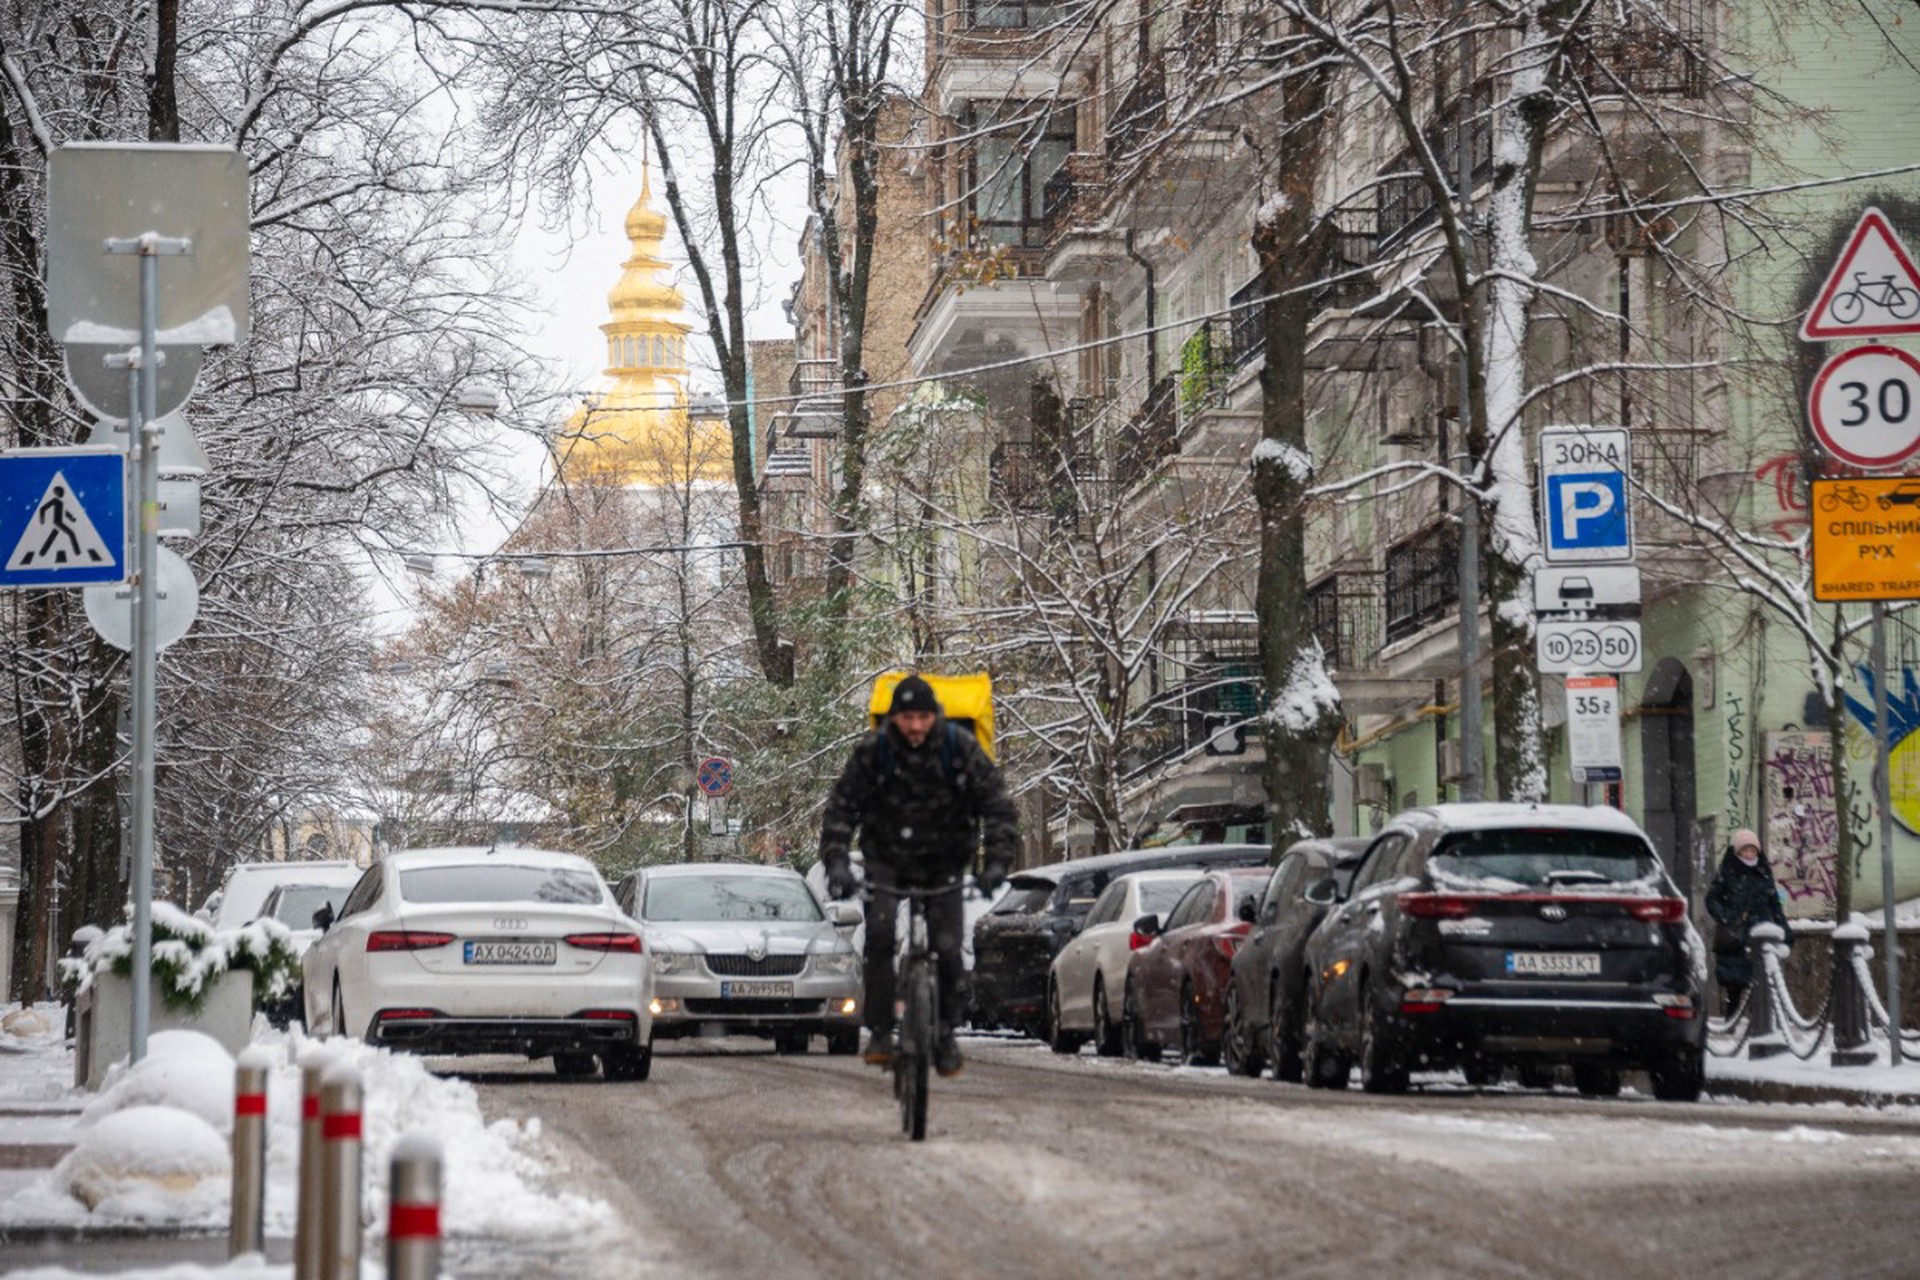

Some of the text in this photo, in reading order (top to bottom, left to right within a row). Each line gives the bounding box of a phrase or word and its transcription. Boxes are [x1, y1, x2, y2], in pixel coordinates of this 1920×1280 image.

[1839, 378, 1911, 427] 30
[1555, 442, 1620, 464] ЗОНА
[1560, 482, 1615, 540] P
[1858, 543, 1896, 559] РУХ
[1820, 582, 1876, 593] SHARED
[1547, 637, 1630, 656] 10 25 50
